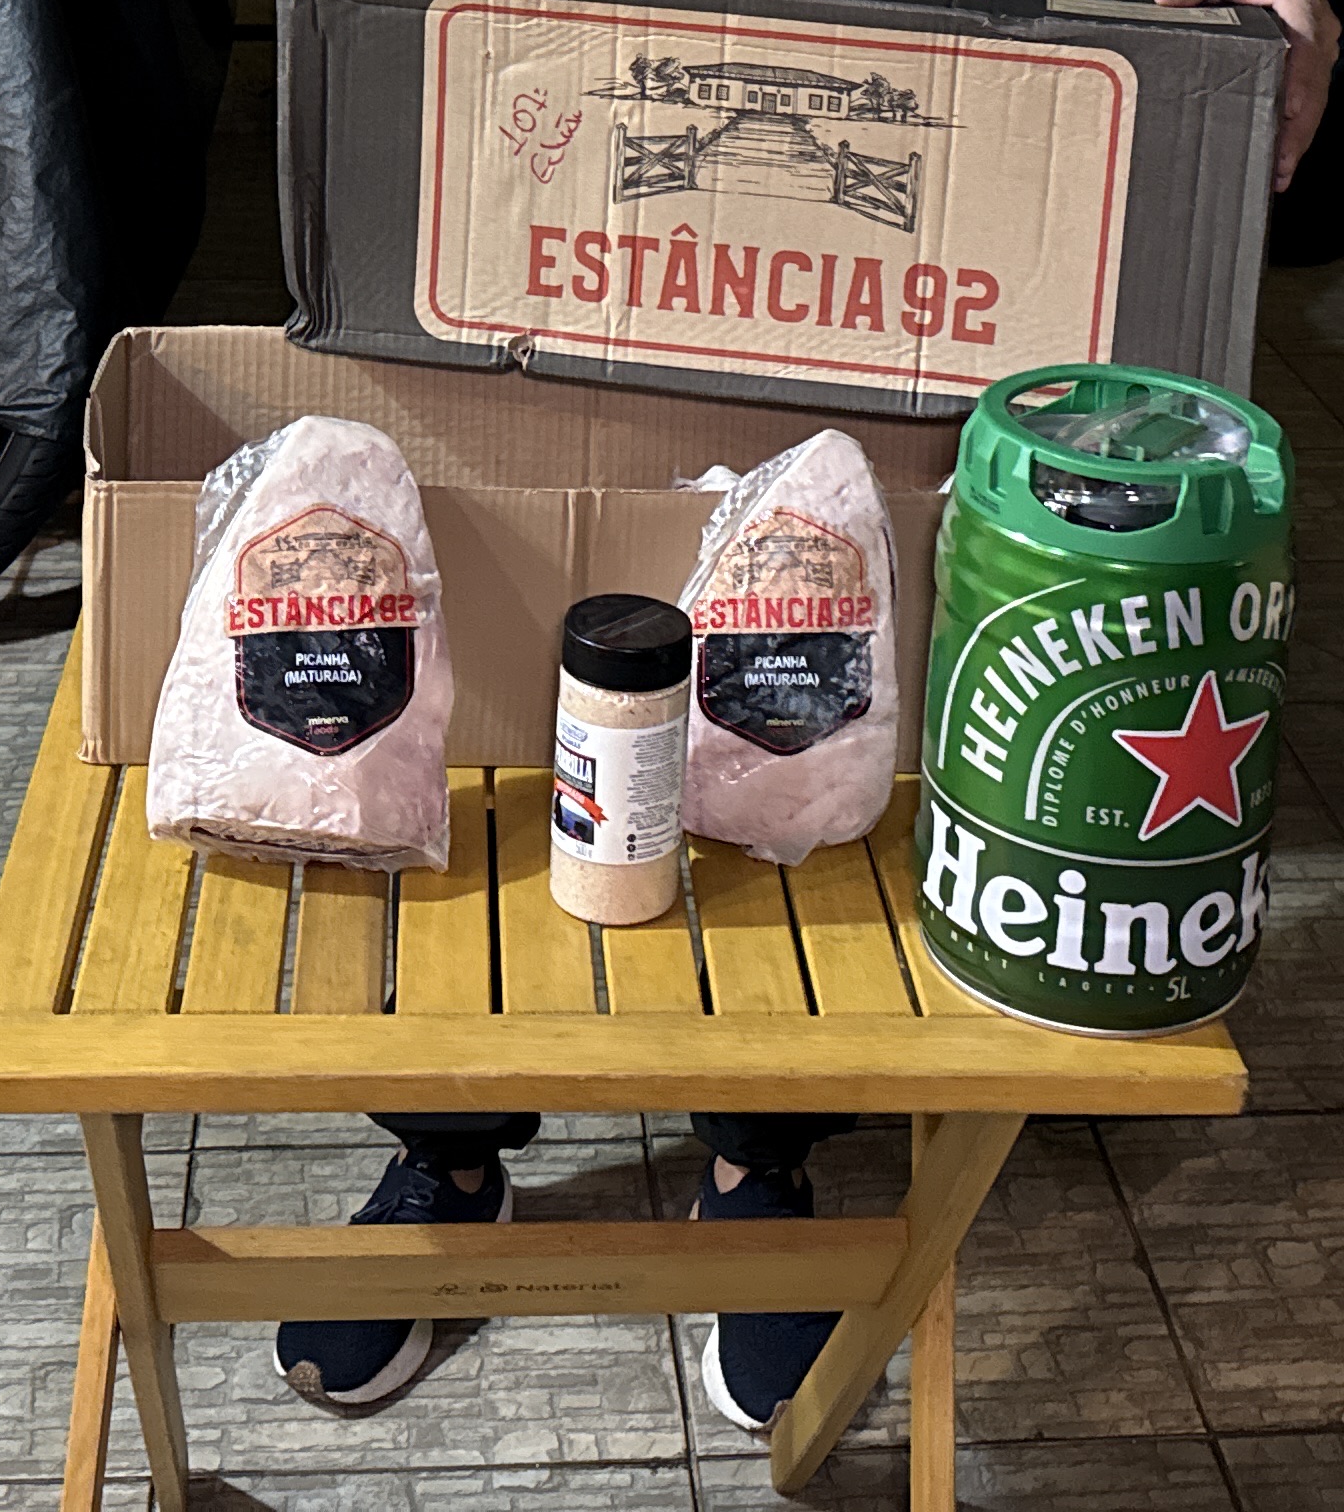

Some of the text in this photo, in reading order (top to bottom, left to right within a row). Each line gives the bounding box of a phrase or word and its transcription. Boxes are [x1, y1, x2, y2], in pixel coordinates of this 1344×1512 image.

[295, 653, 351, 667] PICANHA
[754, 655, 808, 669] PICANHA
[284, 669, 362, 687] (MATURADA)
[744, 672, 820, 688] (MATURADA)
[960, 587, 1205, 783] HEINEKEN
[1041, 737, 1076, 828] DIPLOME
[1069, 674, 1191, 736] D'HONNEUR
[1085, 805, 1131, 829] EST.
